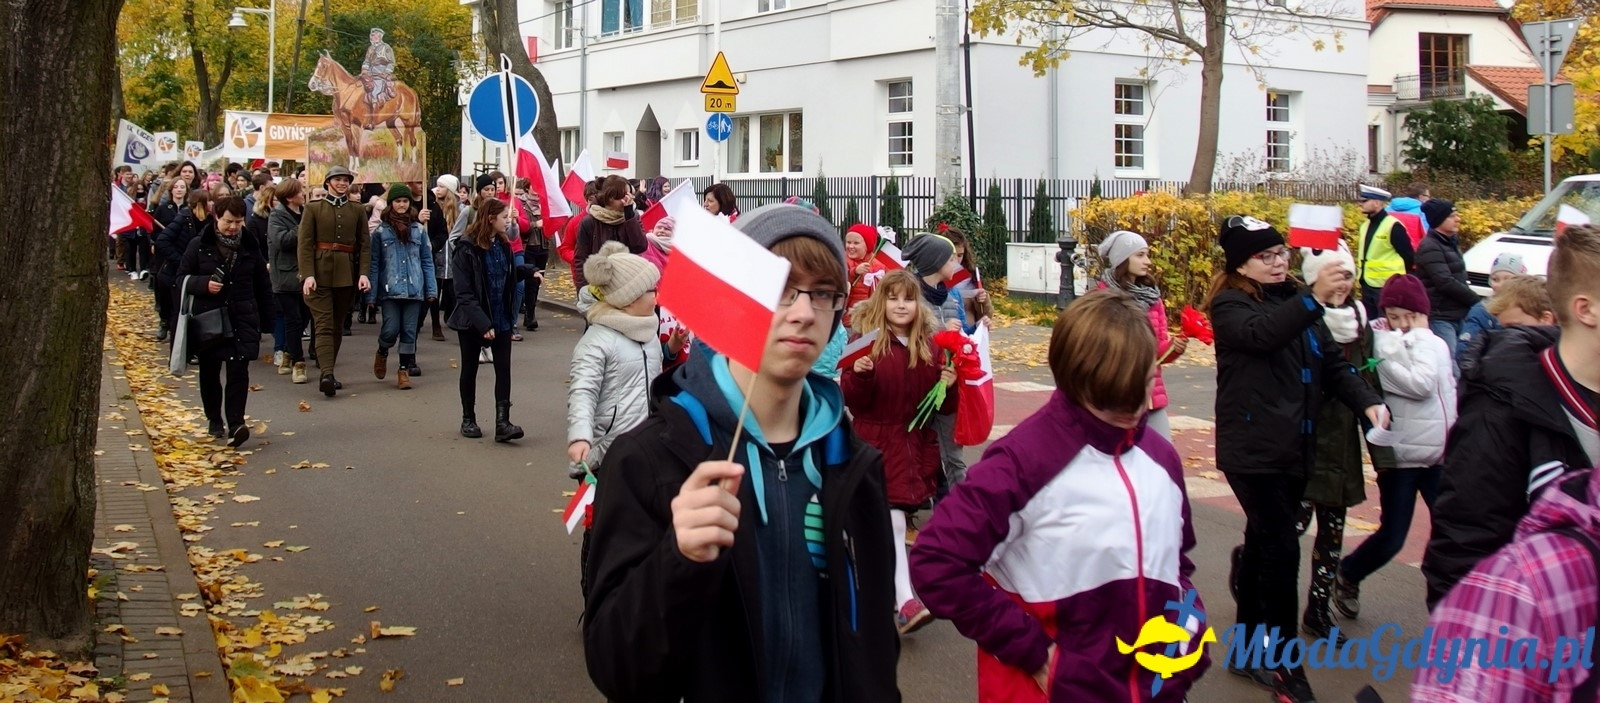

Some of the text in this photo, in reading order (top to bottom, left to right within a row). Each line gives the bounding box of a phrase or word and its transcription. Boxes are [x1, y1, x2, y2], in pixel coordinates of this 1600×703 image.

[710, 98, 722, 108] 20
[136, 129, 155, 143] LICEU
[269, 123, 315, 141] GDYŃS
